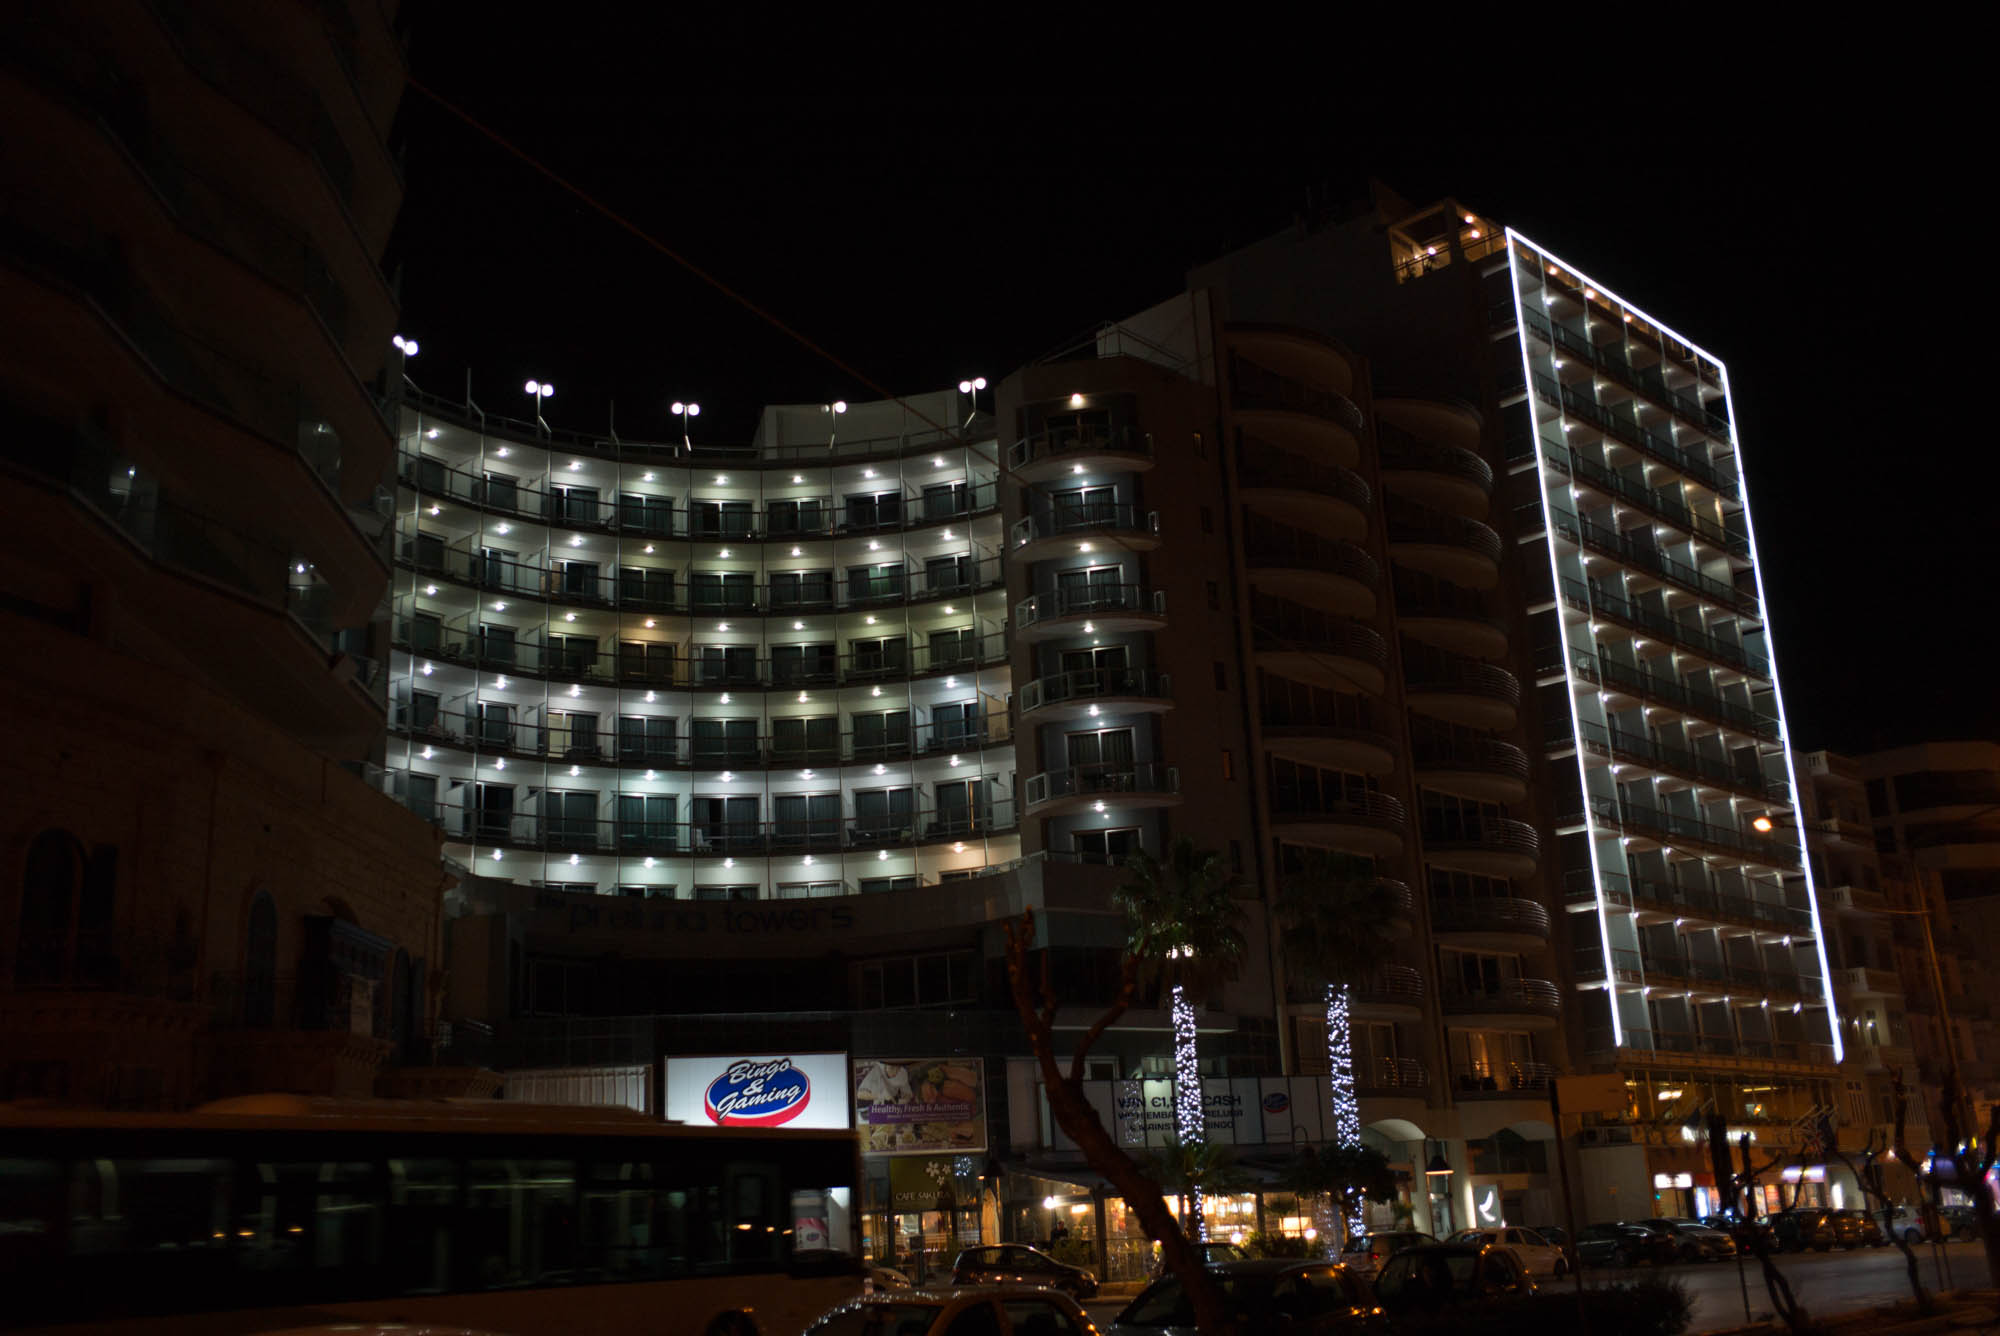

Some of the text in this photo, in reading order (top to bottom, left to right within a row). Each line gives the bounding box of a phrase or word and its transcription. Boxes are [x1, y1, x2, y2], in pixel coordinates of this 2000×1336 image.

[723, 905, 854, 934] towers
[728, 1059, 791, 1084] Bingo
[742, 1078, 765, 1096] &
[716, 1085, 802, 1120] Gaming
[871, 1104, 903, 1114] Healthy,
[904, 1103, 925, 1113] Fresh
[1202, 1095, 1241, 1106] CASH
